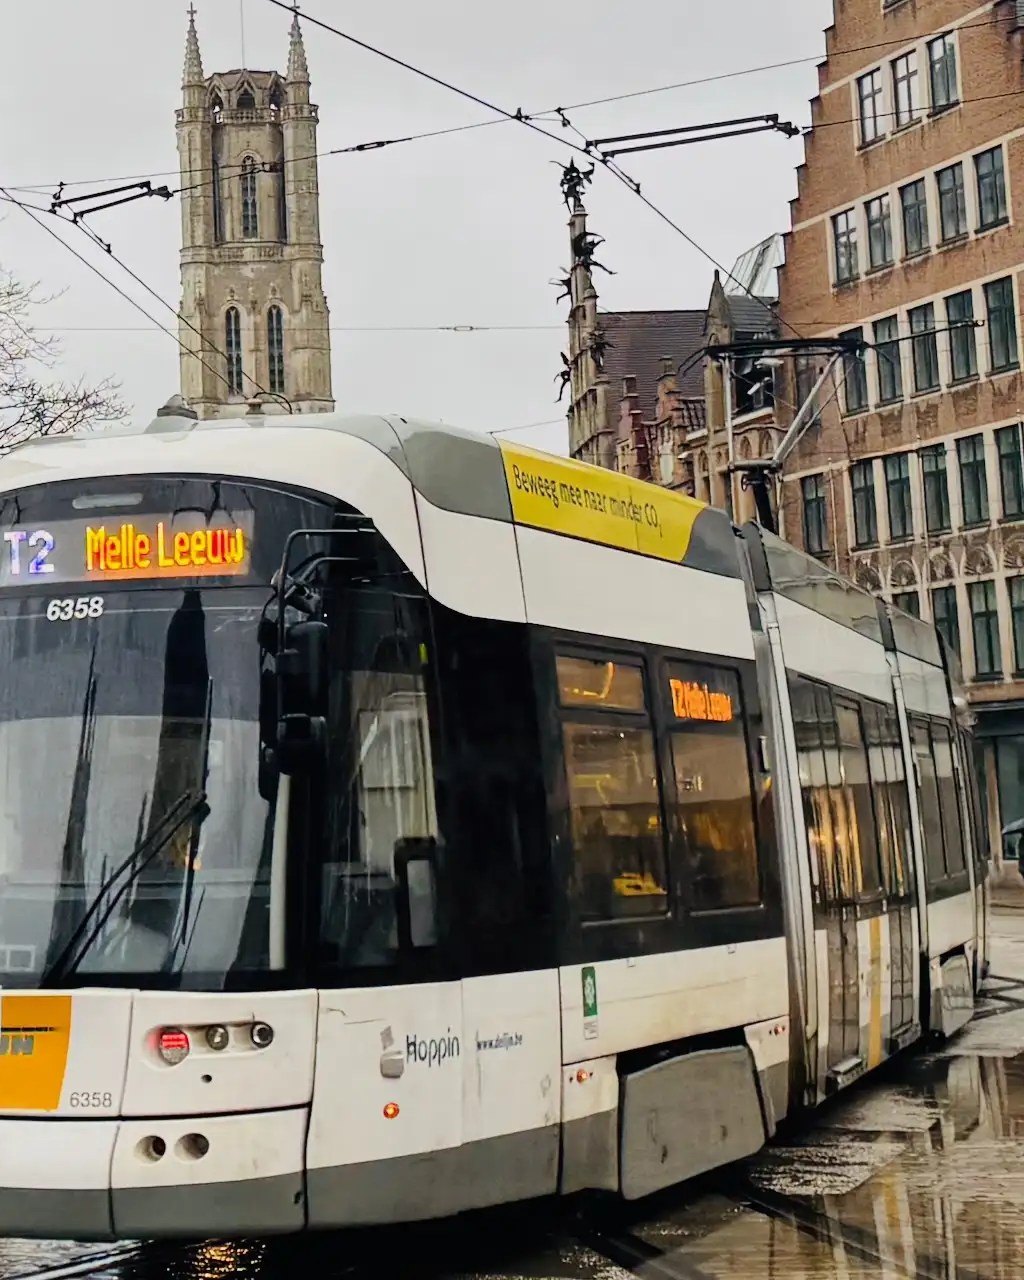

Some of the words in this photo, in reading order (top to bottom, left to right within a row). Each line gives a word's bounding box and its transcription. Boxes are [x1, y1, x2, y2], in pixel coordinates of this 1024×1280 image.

[512, 464, 559, 508] Beweeg
[559, 482, 582, 508] mee
[584, 490, 607, 514] naar
[609, 493, 643, 523] minder
[4, 529, 55, 575] T2
[86, 524, 150, 570] Melle
[157, 522, 243, 567] Leeuw
[47, 596, 104, 621] 6358
[406, 1027, 460, 1067] Hoppin
[70, 1092, 112, 1108] 6358
